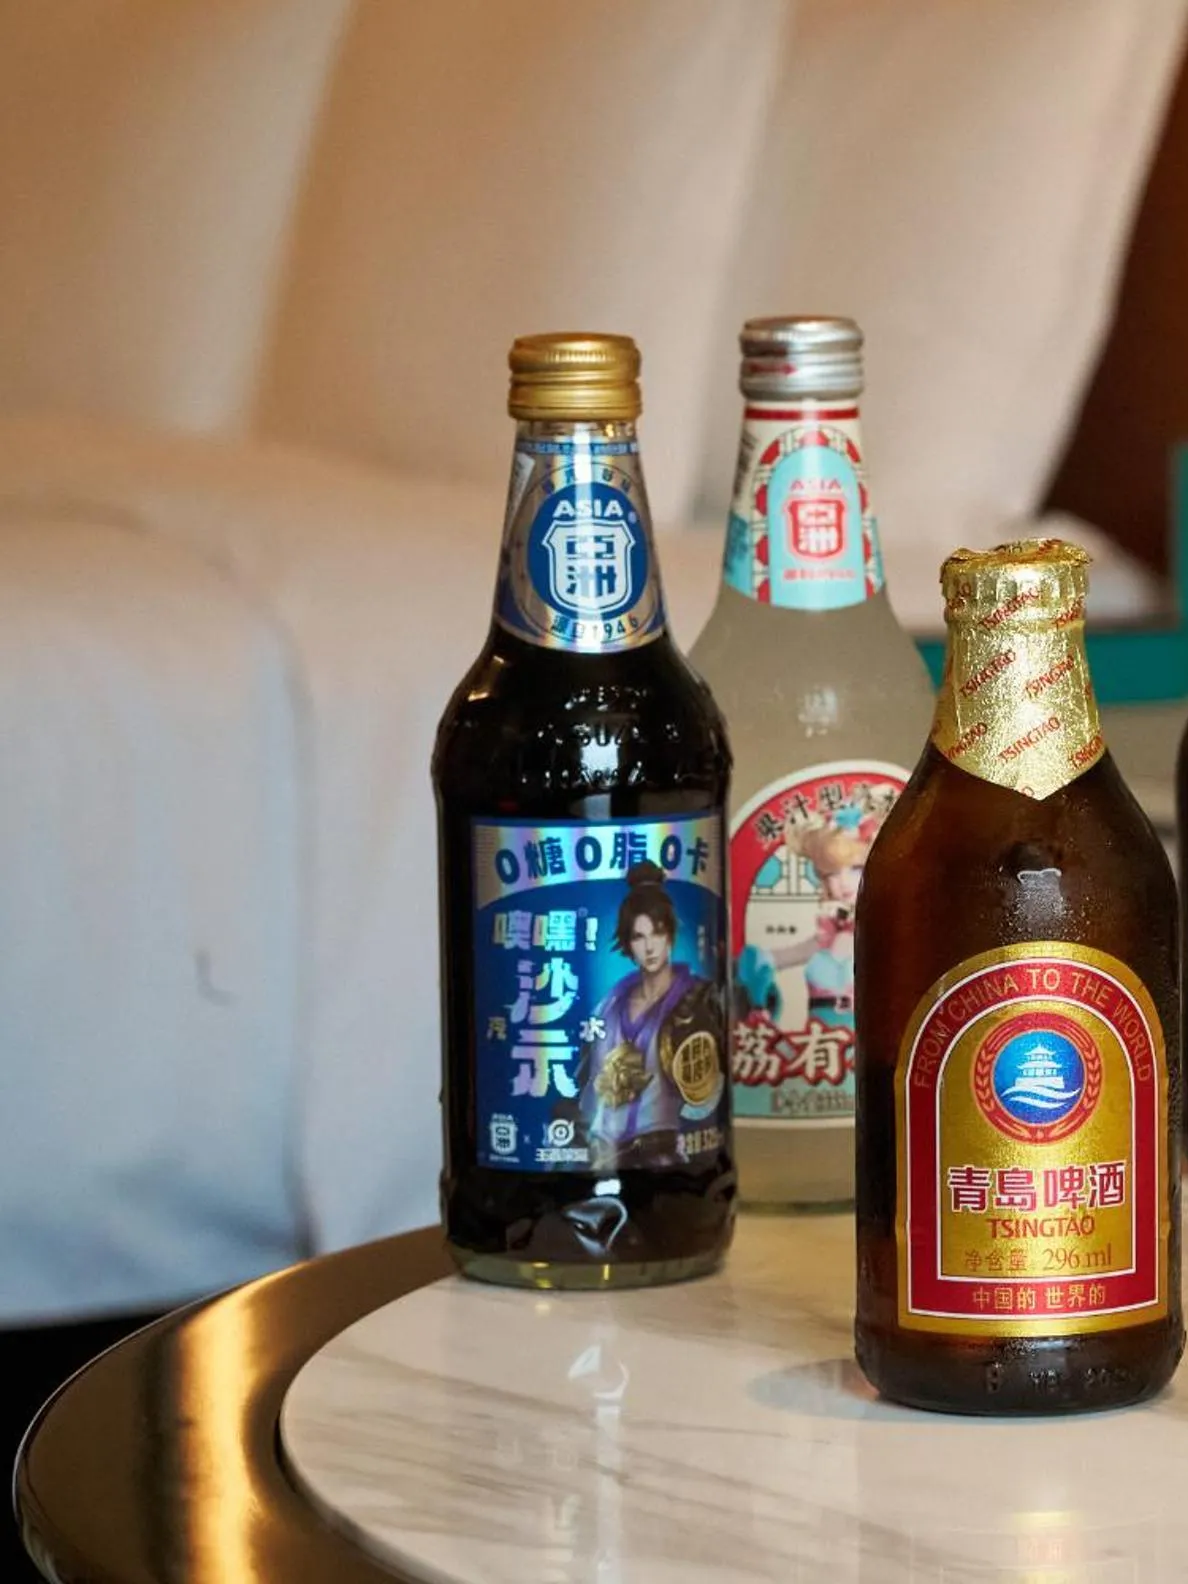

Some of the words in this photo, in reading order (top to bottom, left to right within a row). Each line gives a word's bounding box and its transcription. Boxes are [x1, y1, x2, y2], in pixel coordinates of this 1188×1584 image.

[553, 500, 624, 518] ASIA
[997, 716, 1061, 765] TSINGTAO
[733, 1019, 856, 1080] 荔有
[914, 1016, 949, 1089] FROM
[950, 973, 1020, 1022] CHINA
[1027, 968, 1061, 991] TO
[1071, 971, 1114, 1009] THE
[1111, 996, 1151, 1082] WORLD
[948, 1162, 1127, 1214] 青島啤酒
[986, 1215, 1095, 1239] TSINGTAO
[972, 1285, 1035, 1310] 中国的
[1045, 1283, 1107, 1309] 世界的
